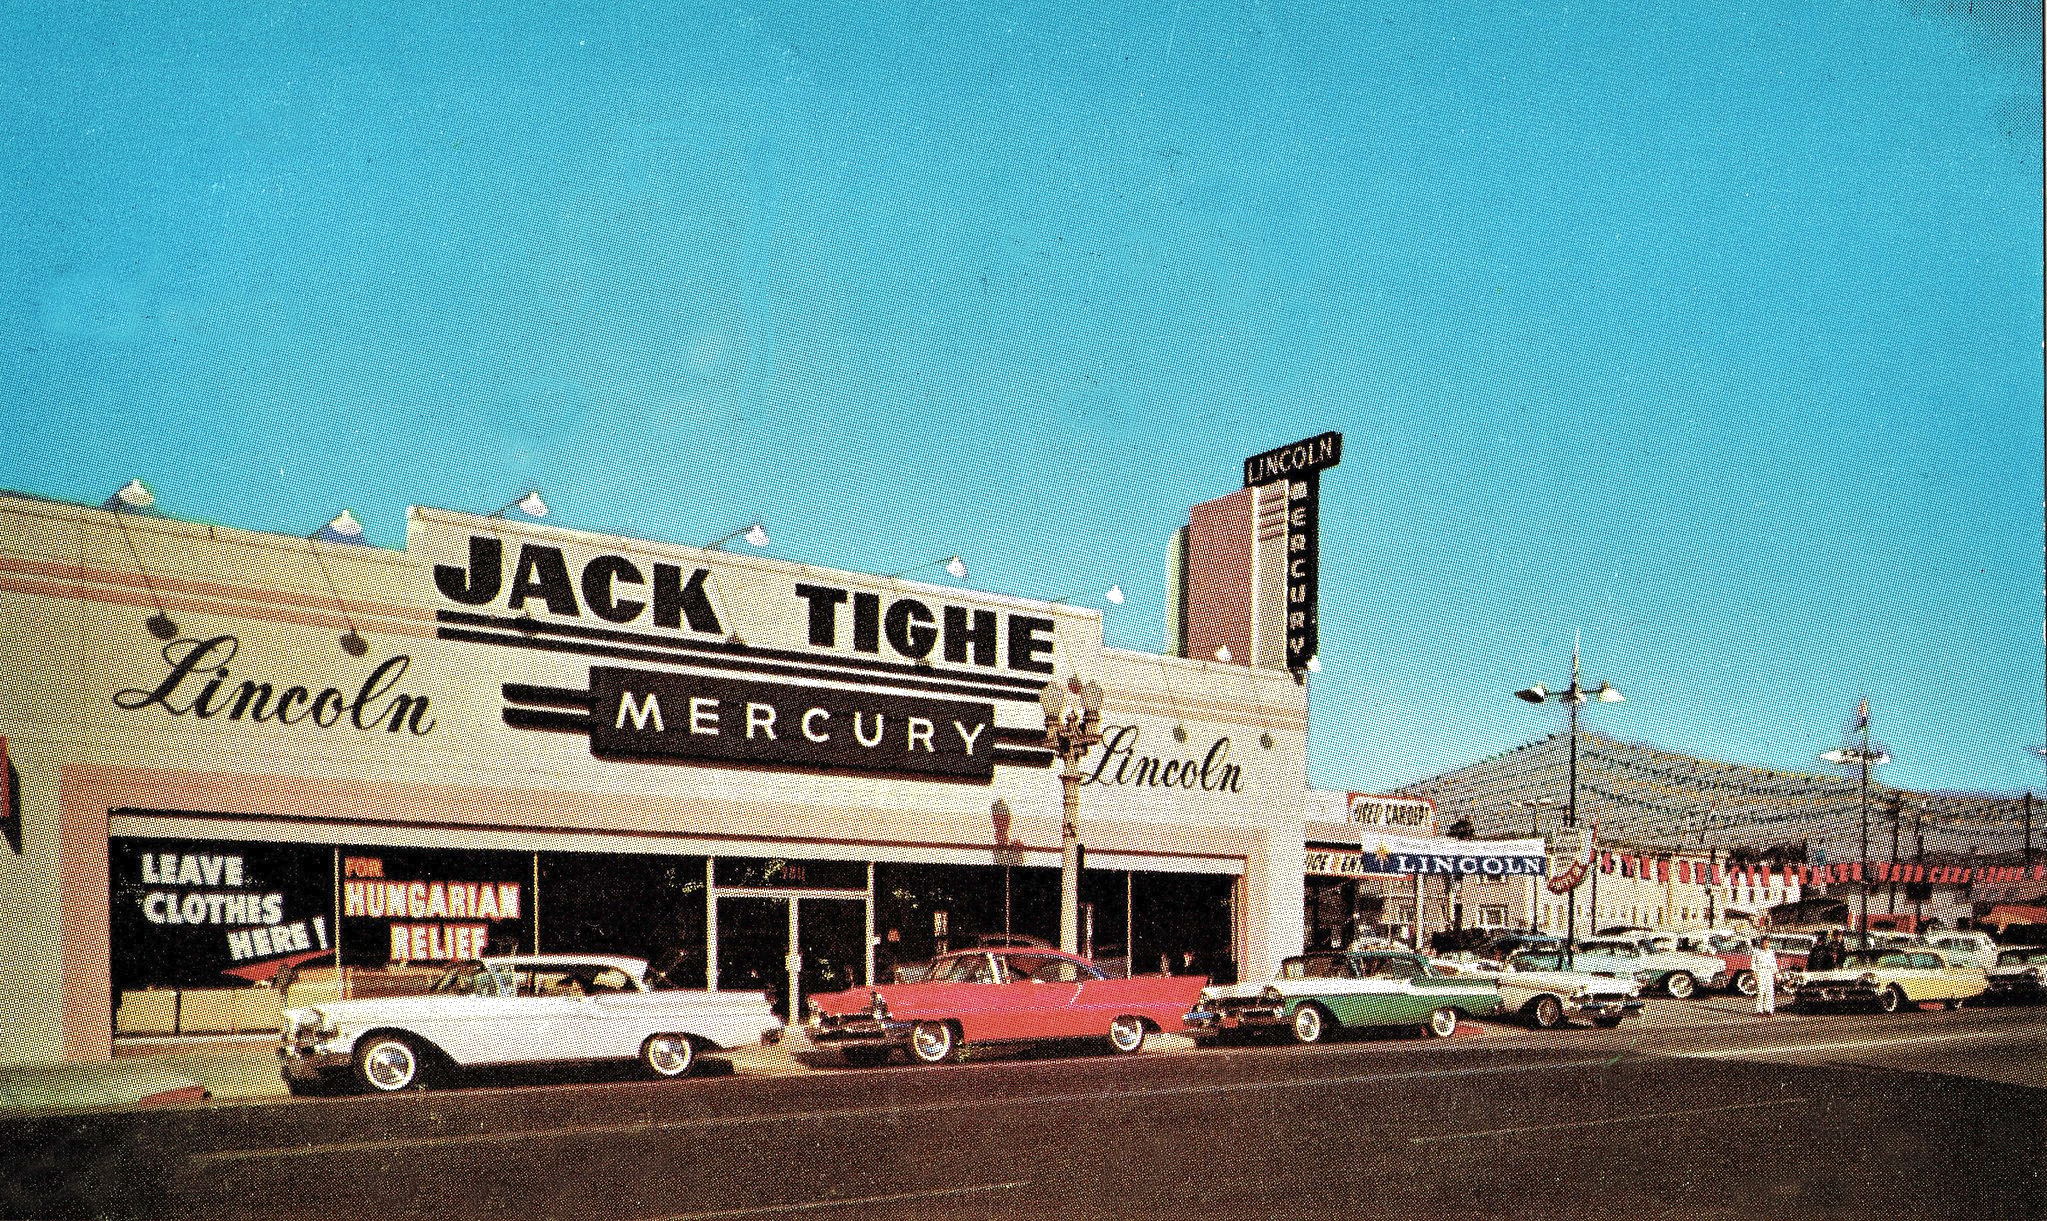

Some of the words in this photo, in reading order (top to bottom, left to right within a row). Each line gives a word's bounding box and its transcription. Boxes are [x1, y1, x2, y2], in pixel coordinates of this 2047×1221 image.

[1248, 436, 1333, 483] LINCOLN
[1289, 480, 1308, 654] MERCURY
[435, 536, 723, 635] JACK
[795, 583, 1055, 674] TIGHE
[114, 635, 436, 736] Lincoln
[616, 691, 986, 757] MERCURY
[1080, 724, 1245, 793] Lincoln
[142, 852, 244, 886] LEAVE
[344, 856, 385, 878] FOR
[1396, 855, 1541, 874] LINCOLN
[143, 891, 284, 925] CLOTHES
[343, 880, 522, 920] HUNGARIAN
[389, 922, 489, 961] RELIEF
